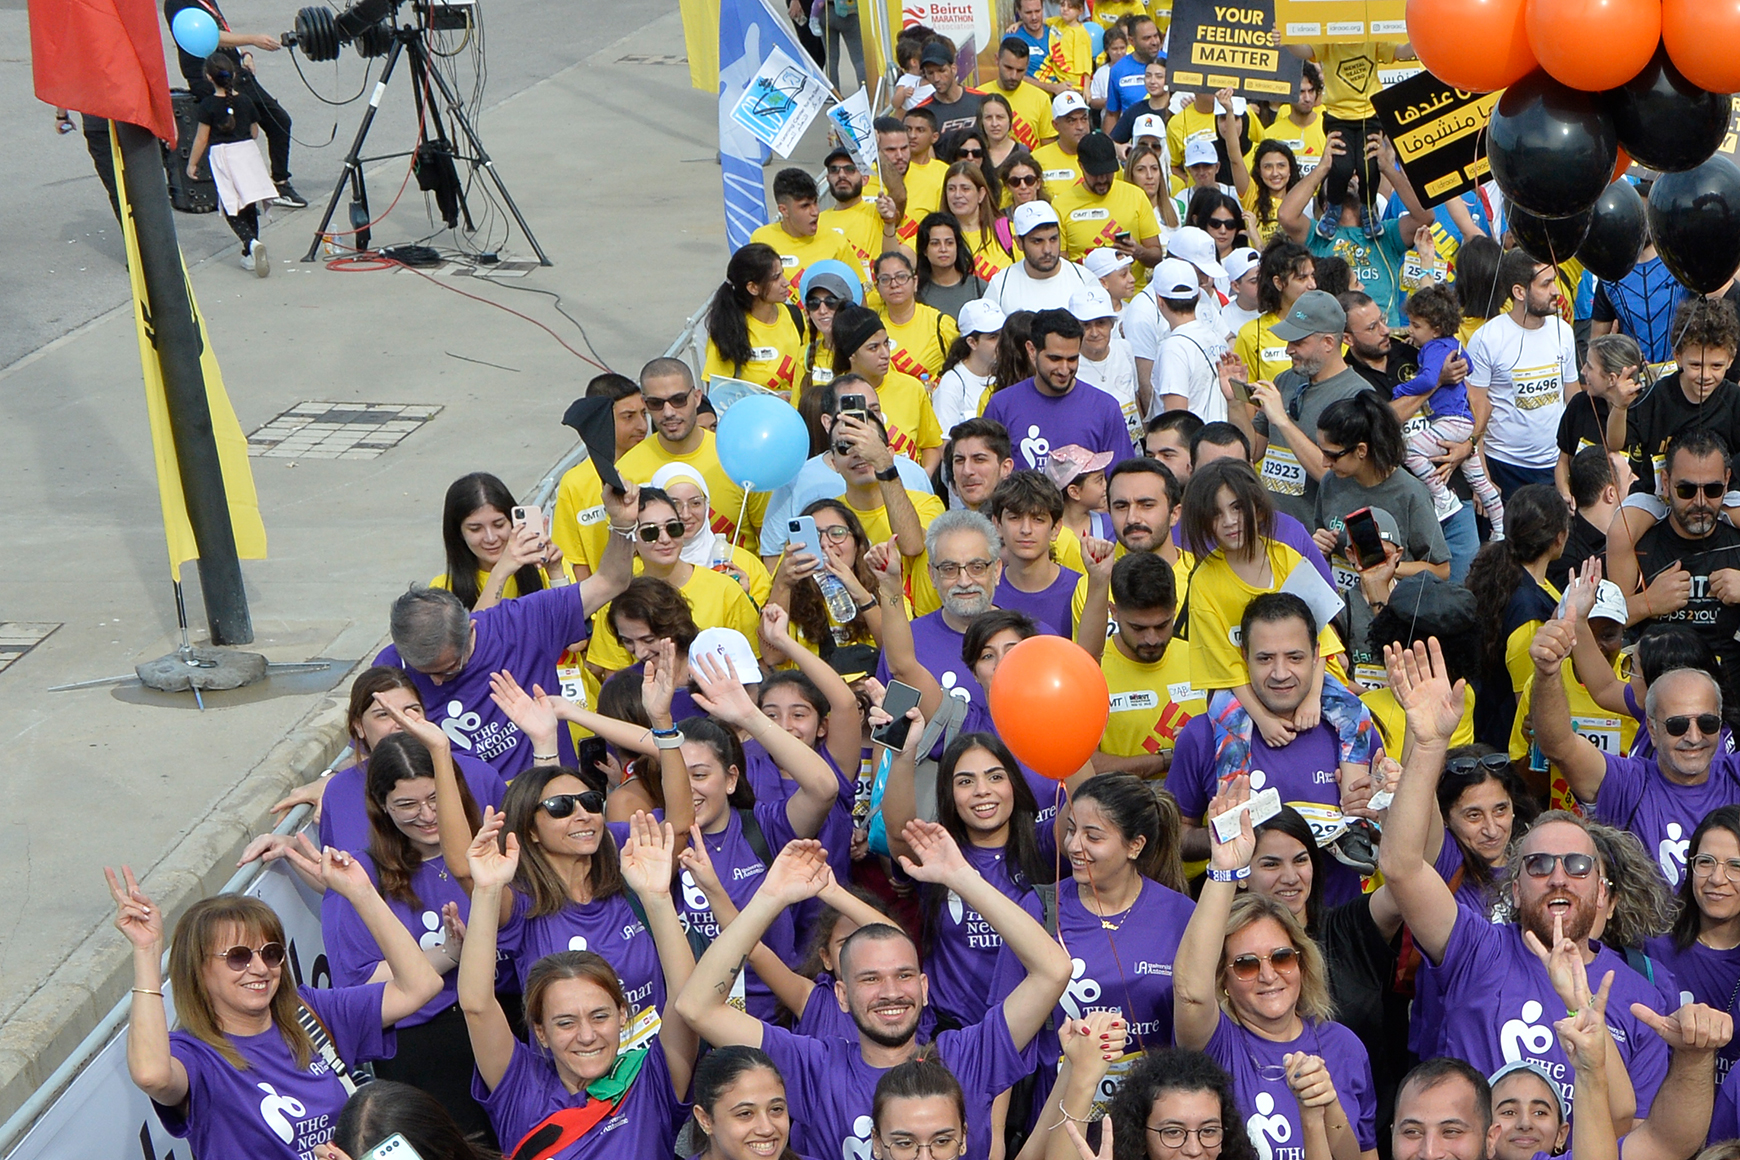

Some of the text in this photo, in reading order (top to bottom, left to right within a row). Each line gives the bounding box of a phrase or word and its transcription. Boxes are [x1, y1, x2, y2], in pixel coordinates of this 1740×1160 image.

[930, 4, 973, 14] Beirut
[931, 14, 974, 23] MARATHON
[1214, 6, 1264, 25] YOUR
[1197, 25, 1275, 47] FEELINGS
[1200, 46, 1270, 66] MATTER
[1517, 376, 1558, 395] 26496
[1263, 460, 1302, 480] 32923
[581, 509, 601, 520] OMT
